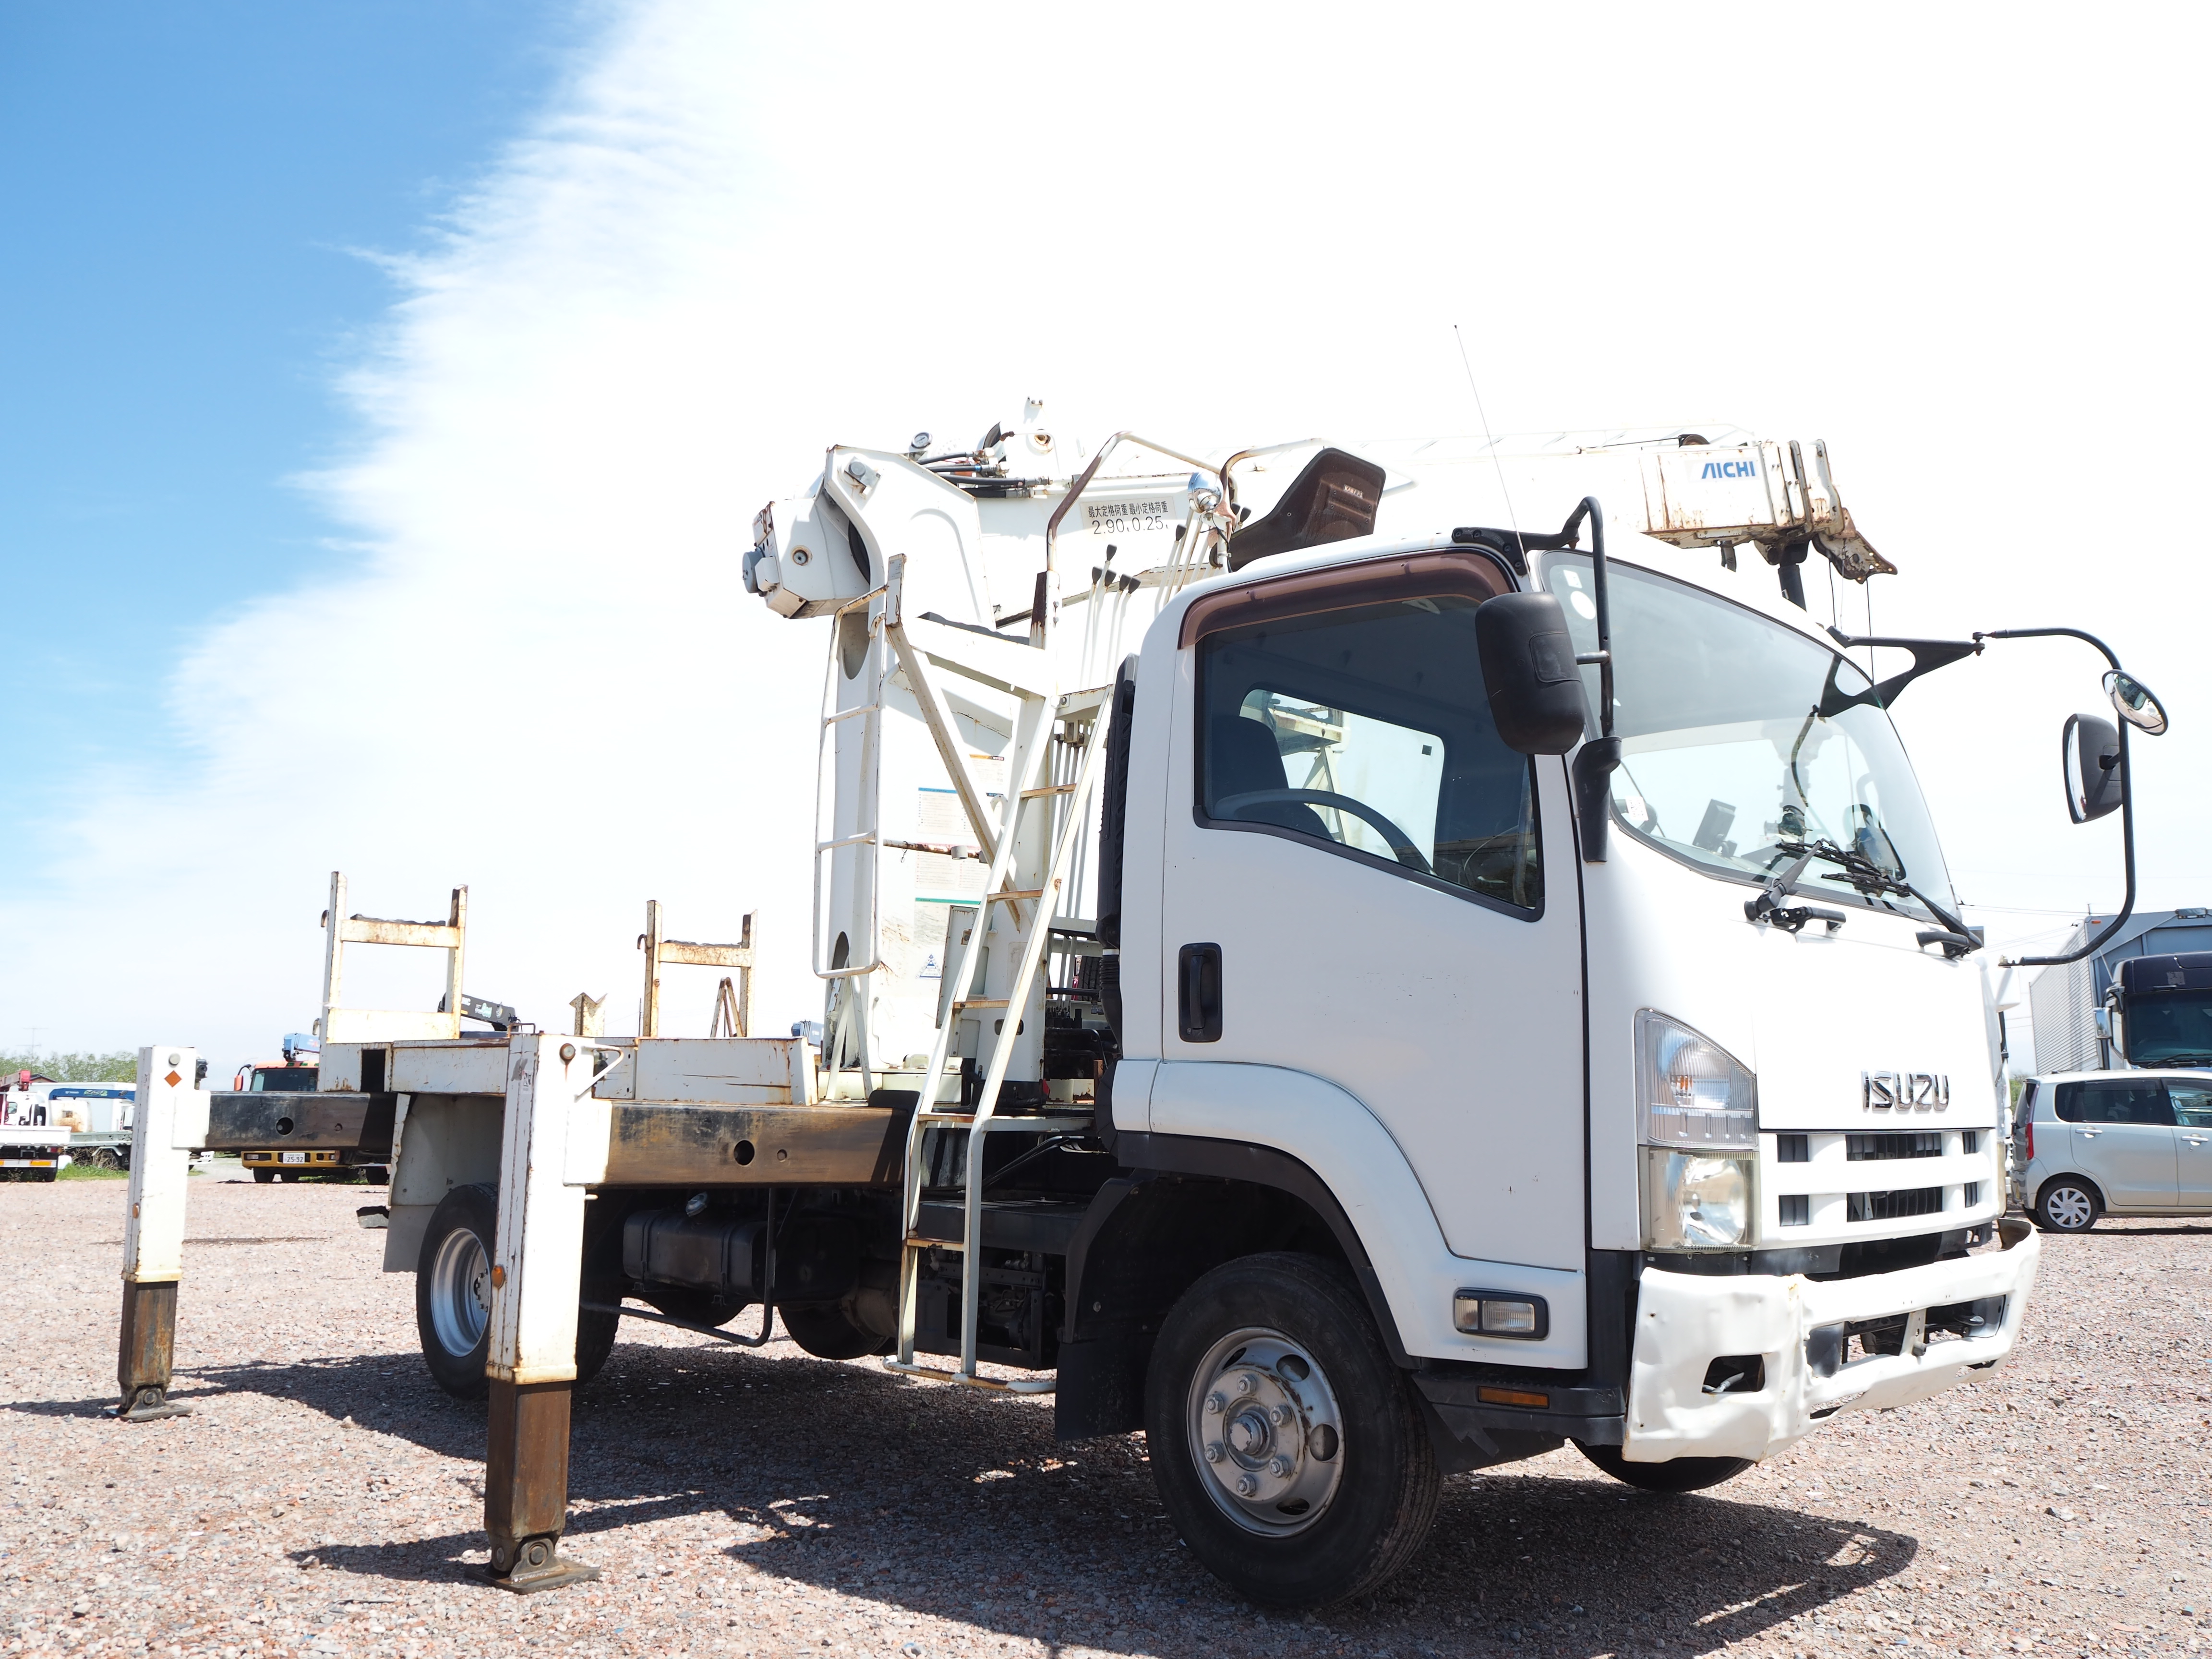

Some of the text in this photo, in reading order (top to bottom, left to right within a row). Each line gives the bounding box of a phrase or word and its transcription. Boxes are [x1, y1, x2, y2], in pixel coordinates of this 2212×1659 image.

[1701, 461, 1756, 479] AICHI
[1088, 501, 1169, 518] 最大定格荷重 最小定格荷重
[1861, 1069, 1949, 1112] ISUZU
